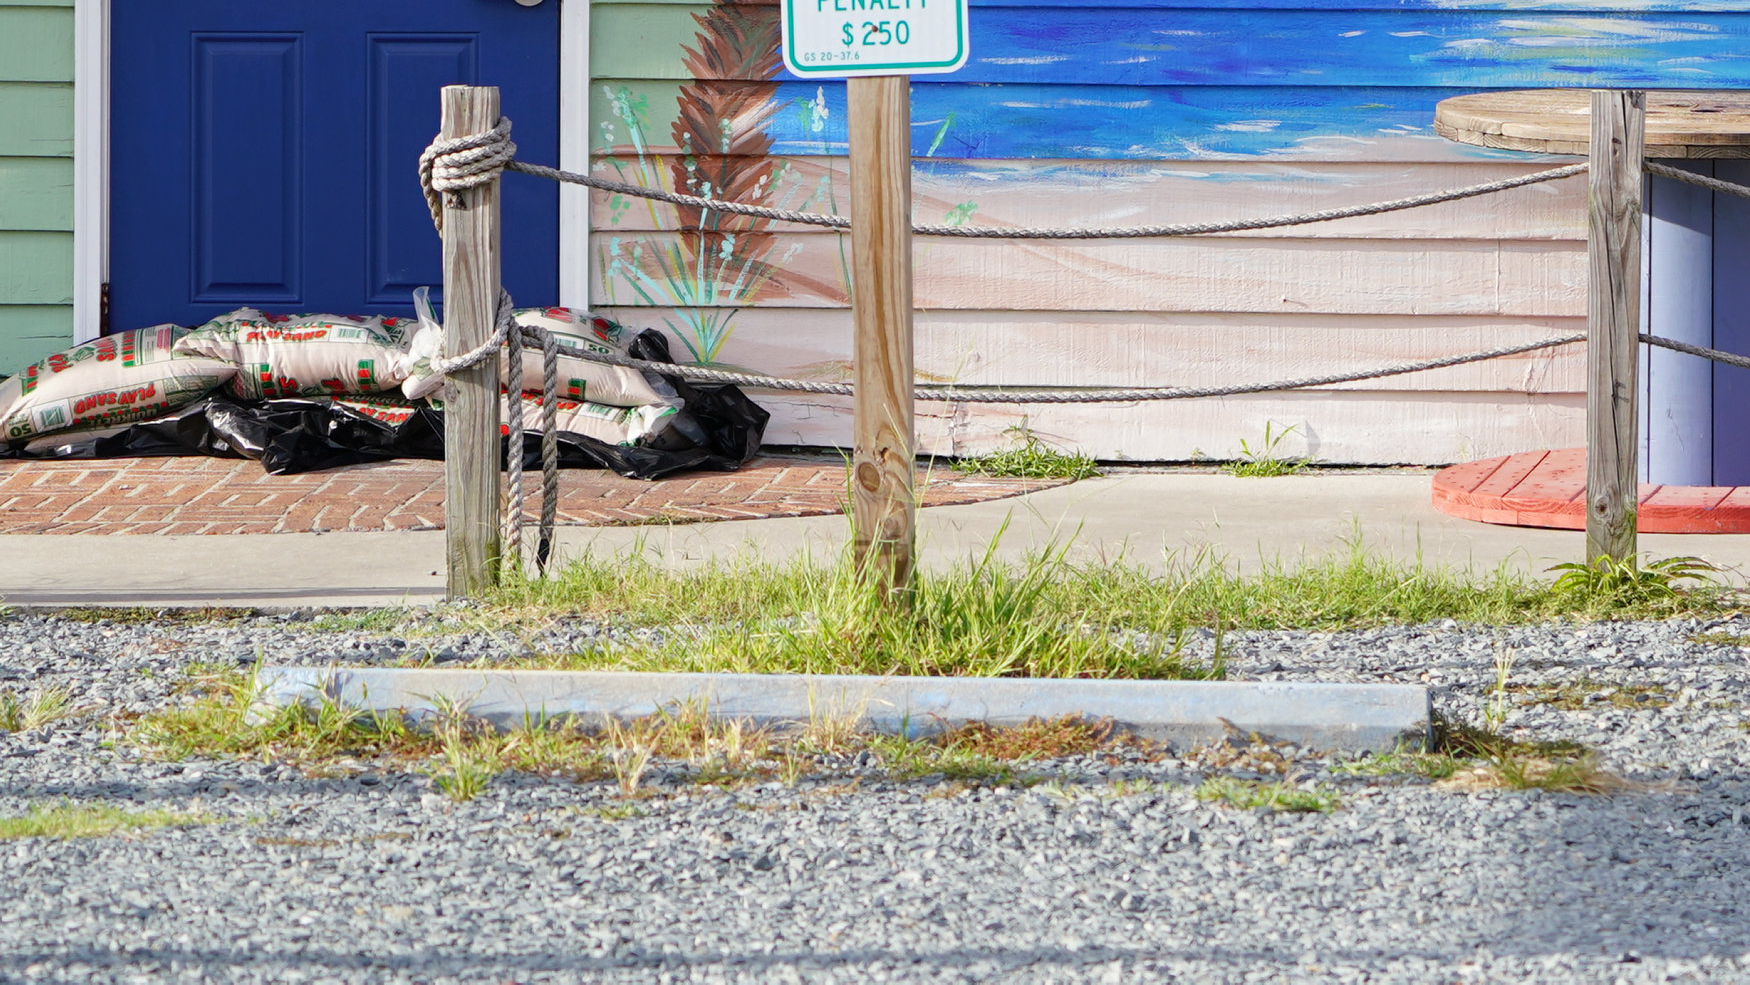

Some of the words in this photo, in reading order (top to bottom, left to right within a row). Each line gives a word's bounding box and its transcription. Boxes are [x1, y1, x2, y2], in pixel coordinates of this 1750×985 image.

[803, 52, 816, 62] GS
[282, 329, 327, 342] SAND
[588, 343, 610, 355] 50
[118, 382, 156, 405] PLAY
[74, 391, 118, 415] SAND
[375, 411, 410, 423] SAN
[10, 423, 32, 437] 50
